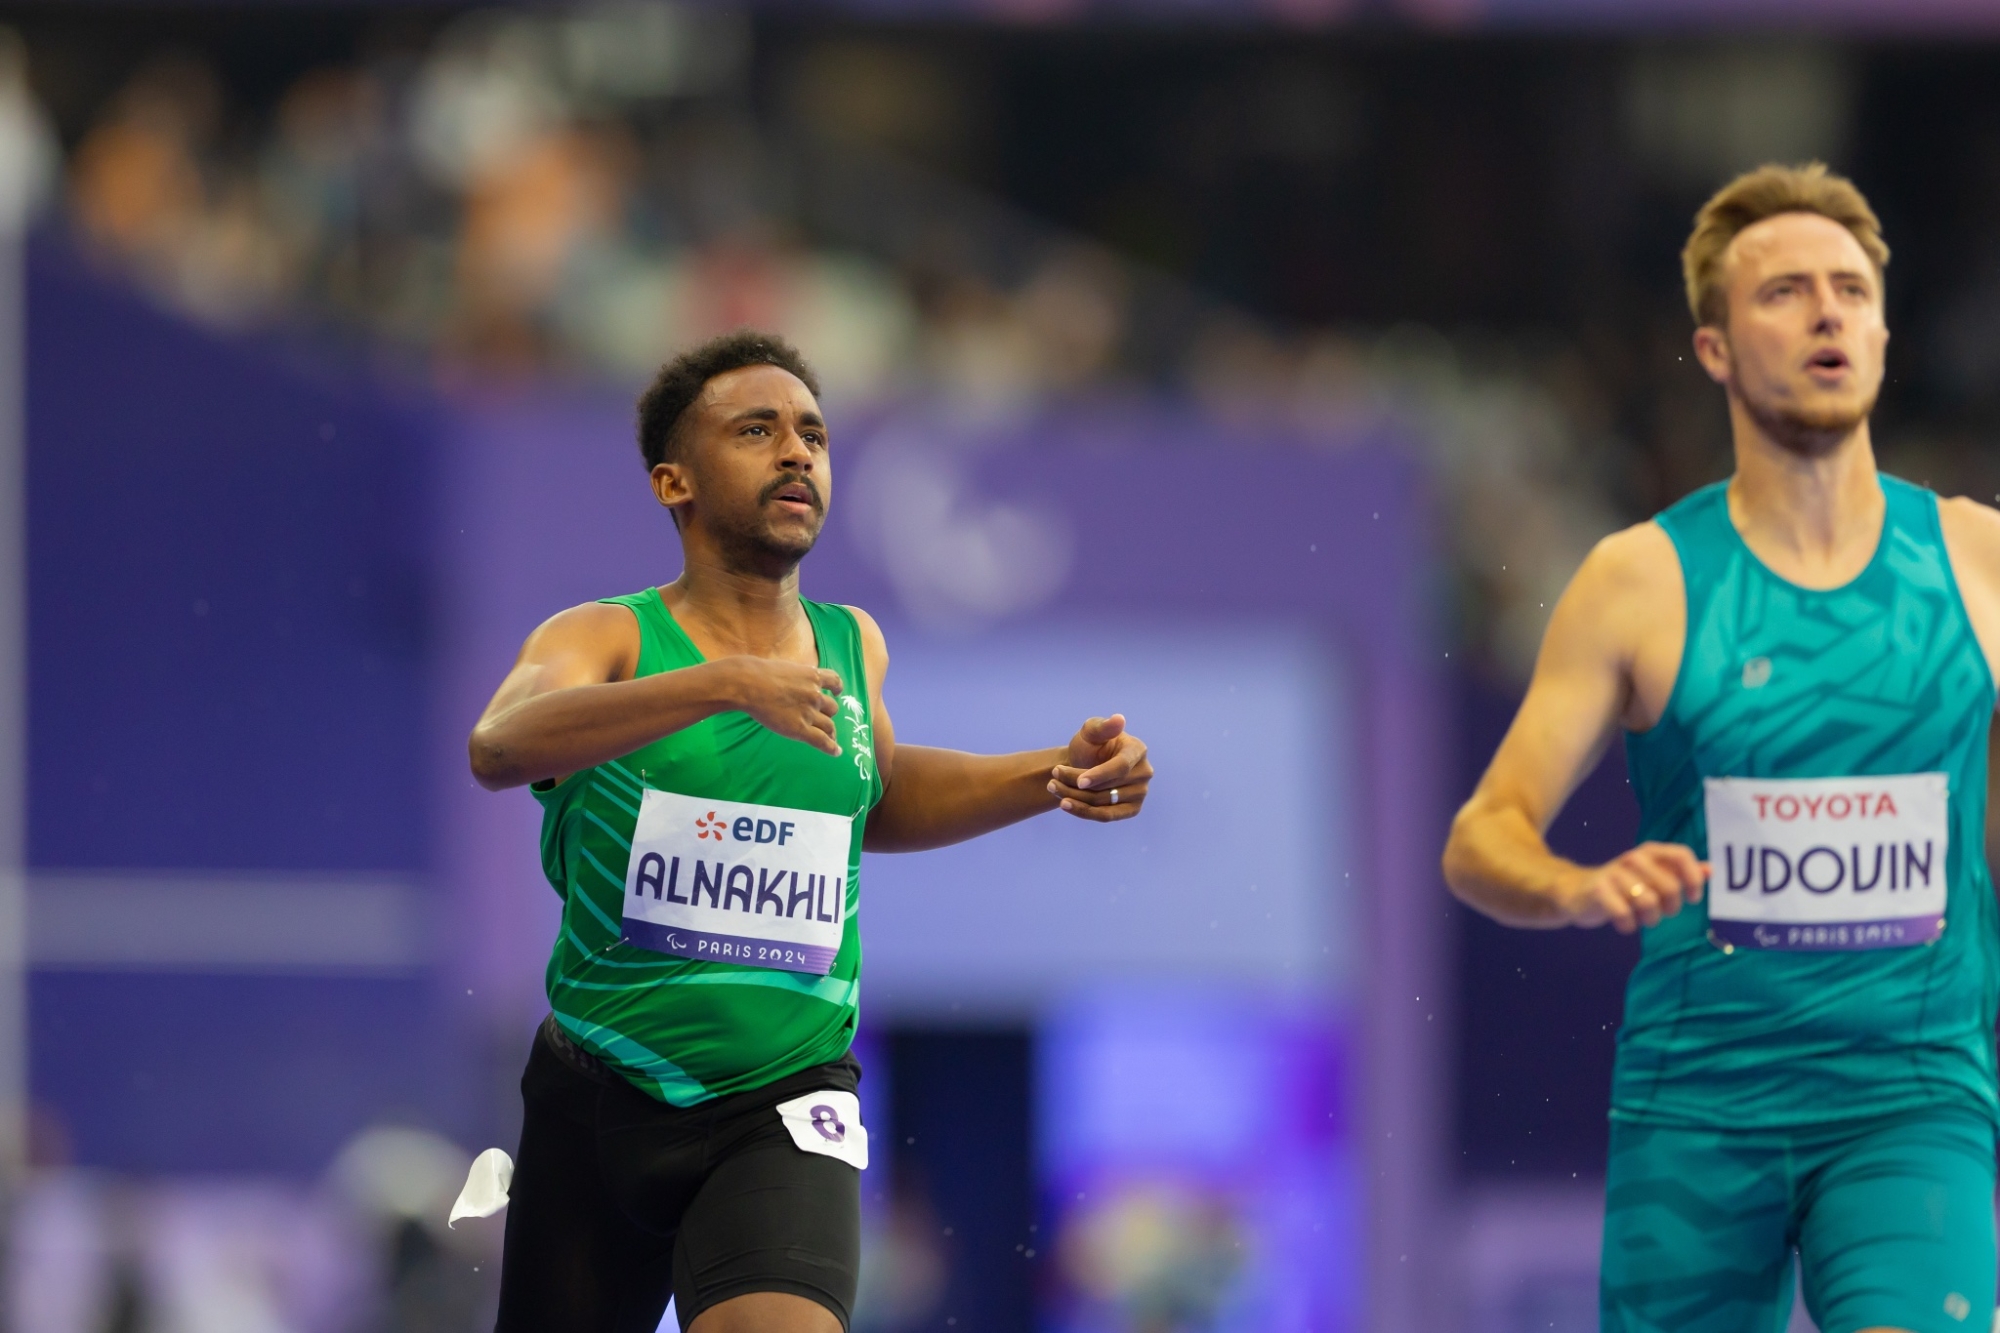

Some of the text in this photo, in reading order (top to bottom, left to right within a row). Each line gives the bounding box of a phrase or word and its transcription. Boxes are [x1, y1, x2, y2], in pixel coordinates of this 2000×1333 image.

[1753, 793, 1897, 821] TOYOTA
[635, 852, 842, 924] ALNAKHLI
[1788, 927, 1849, 945] PARIS
[697, 939, 806, 965] PARIS 2024
[810, 1105, 845, 1143] 8
